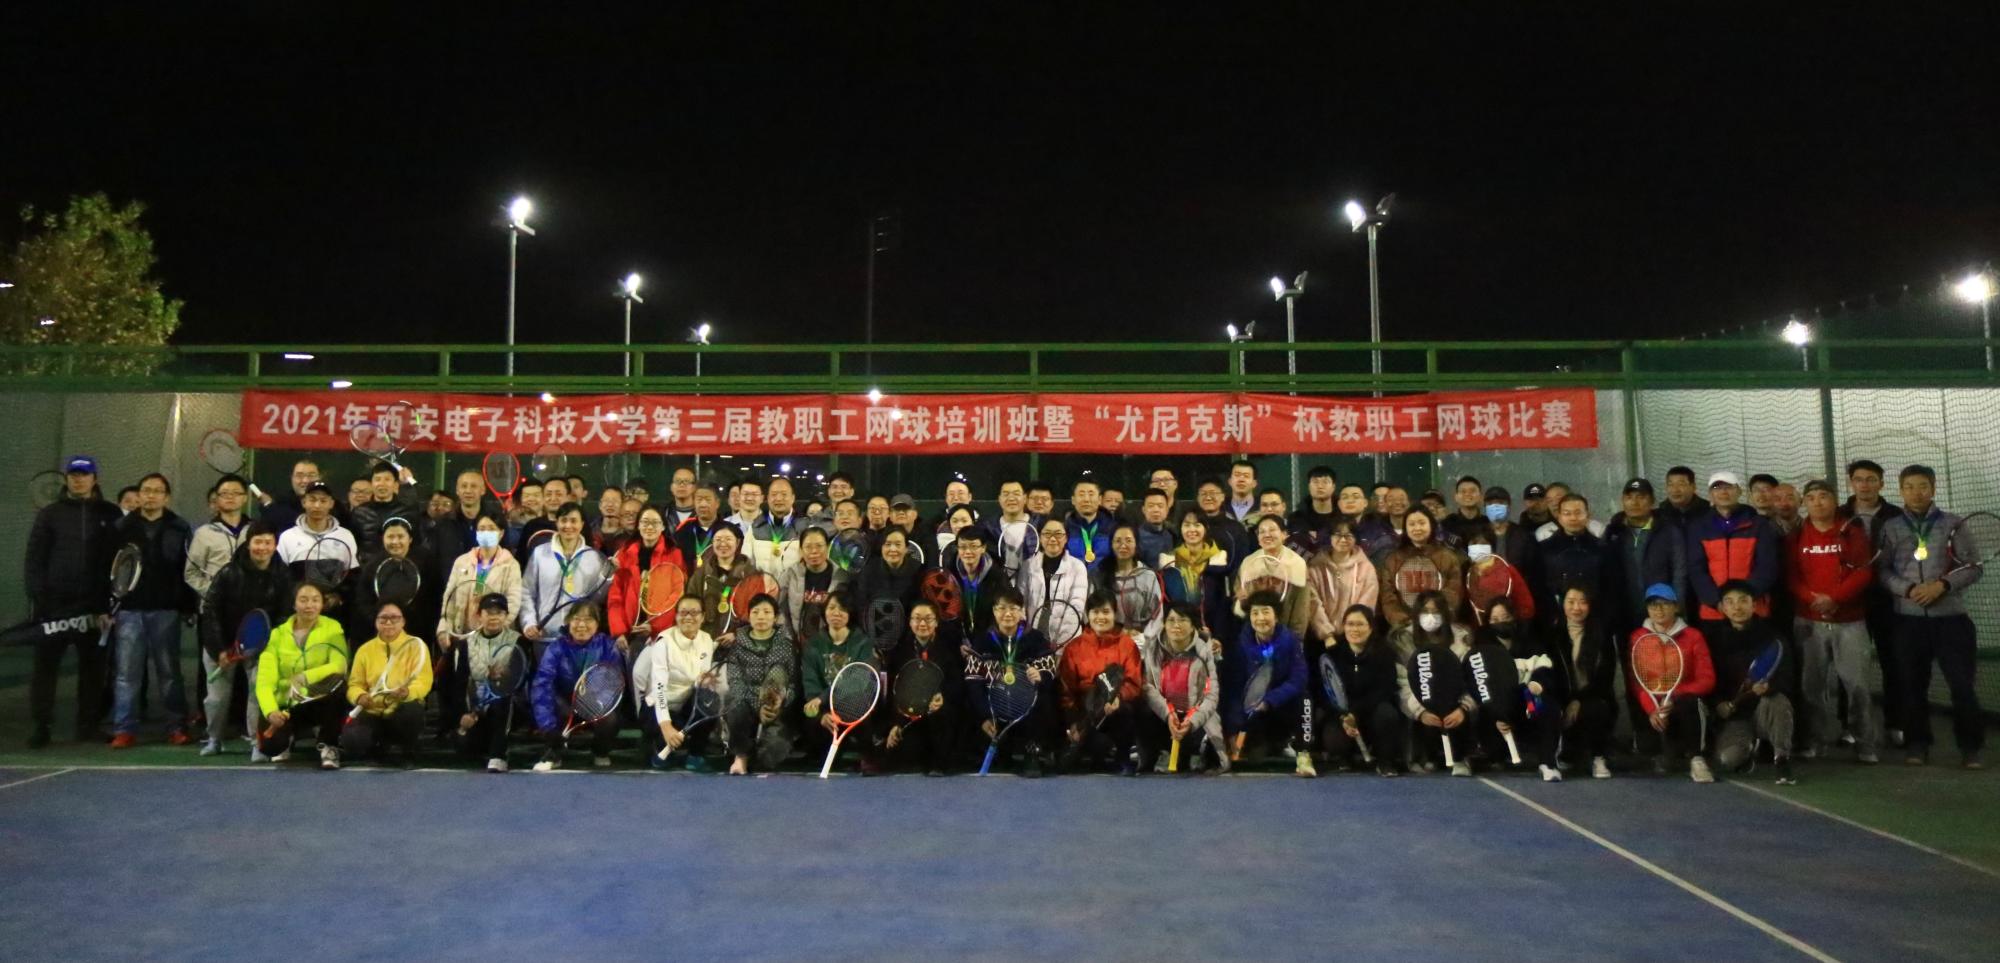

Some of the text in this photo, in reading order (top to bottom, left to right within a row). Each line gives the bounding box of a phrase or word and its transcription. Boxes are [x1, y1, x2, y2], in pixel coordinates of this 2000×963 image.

[1417, 651, 1433, 701] Wilson
[1469, 651, 1490, 703] Wilson
[1301, 698, 1312, 742] adidas
